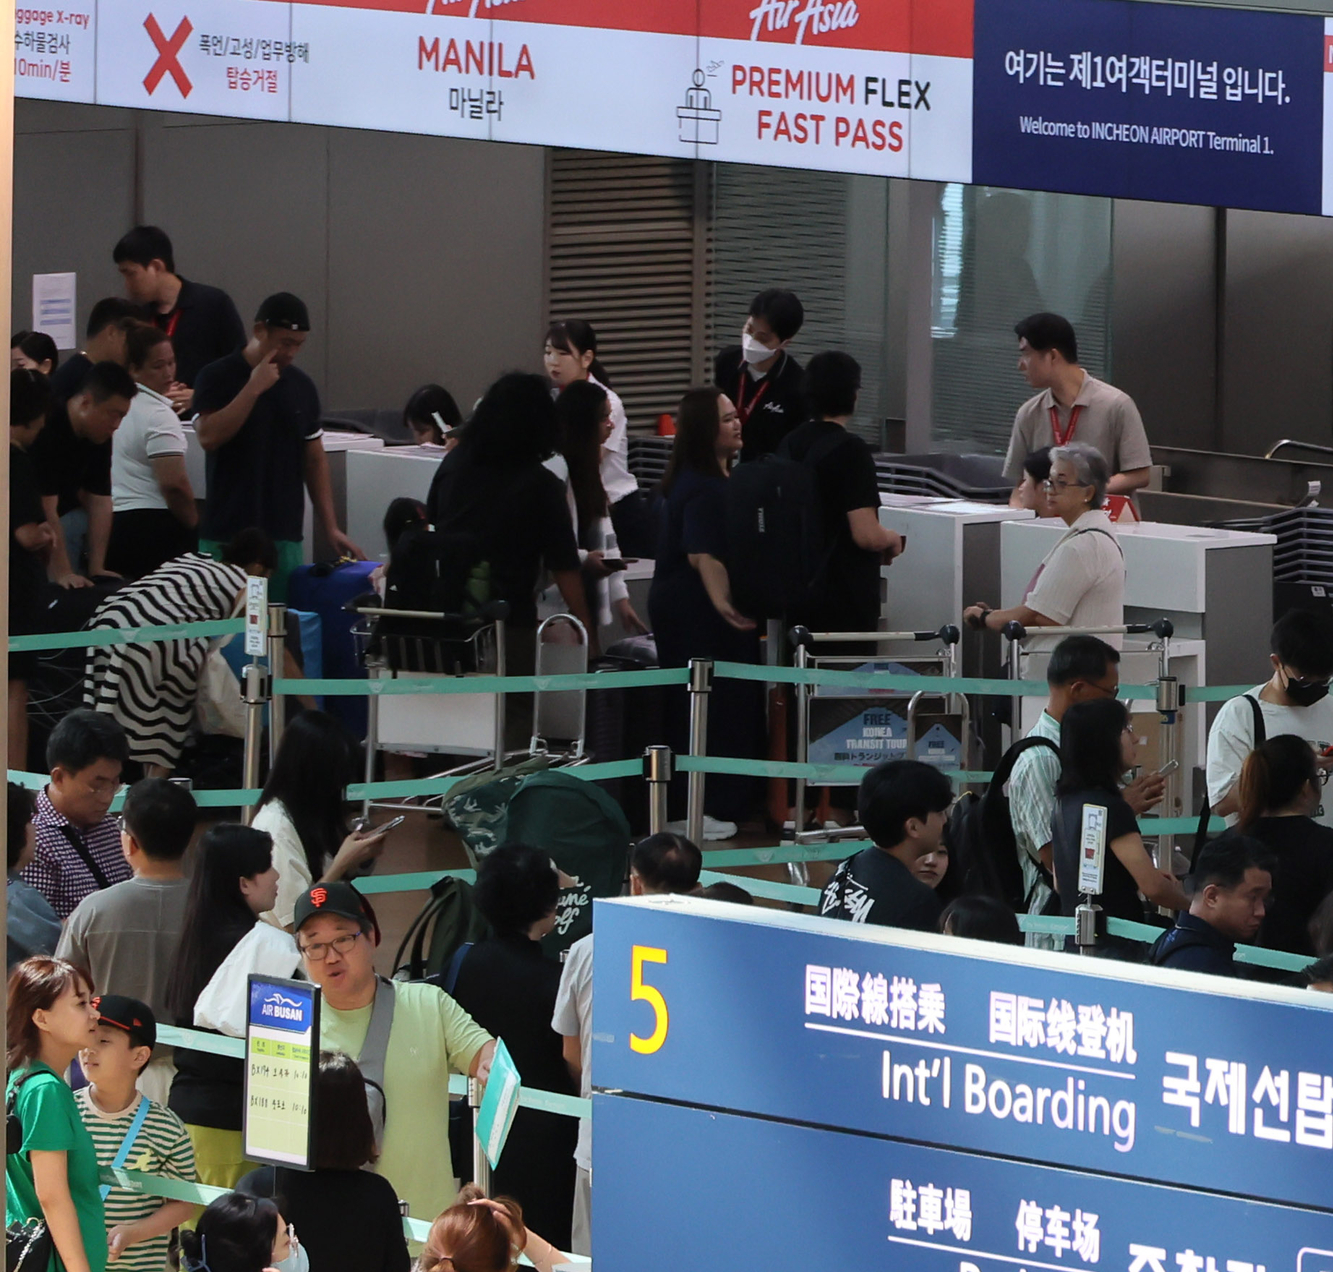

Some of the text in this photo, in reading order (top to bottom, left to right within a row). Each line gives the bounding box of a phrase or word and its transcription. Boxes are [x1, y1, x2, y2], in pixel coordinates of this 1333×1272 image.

[56, 10, 90, 29] X-ray
[199, 34, 310, 63] 폭언/고성/업무방해
[417, 36, 535, 80] MANILA
[226, 66, 278, 93] 탑승거절
[731, 64, 931, 111] PREMIUM FLEX
[1005, 50, 1290, 105] 여기는 제1여객터미널 입니다.
[449, 87, 504, 122] 마닐라
[757, 110, 903, 152] FAST PASS
[1020, 116, 1274, 154] Welcome to INCHEON AIRPORT Terminal 1.
[863, 713, 891, 726] FREE
[262, 1004, 303, 1021] AIR BUSAN
[629, 945, 669, 1054] 5
[805, 964, 1137, 1065] 国際線搭乗 国际线登机
[964, 1062, 1136, 1153] Boarding
[889, 1178, 1100, 1264] 駐車場 停车场
